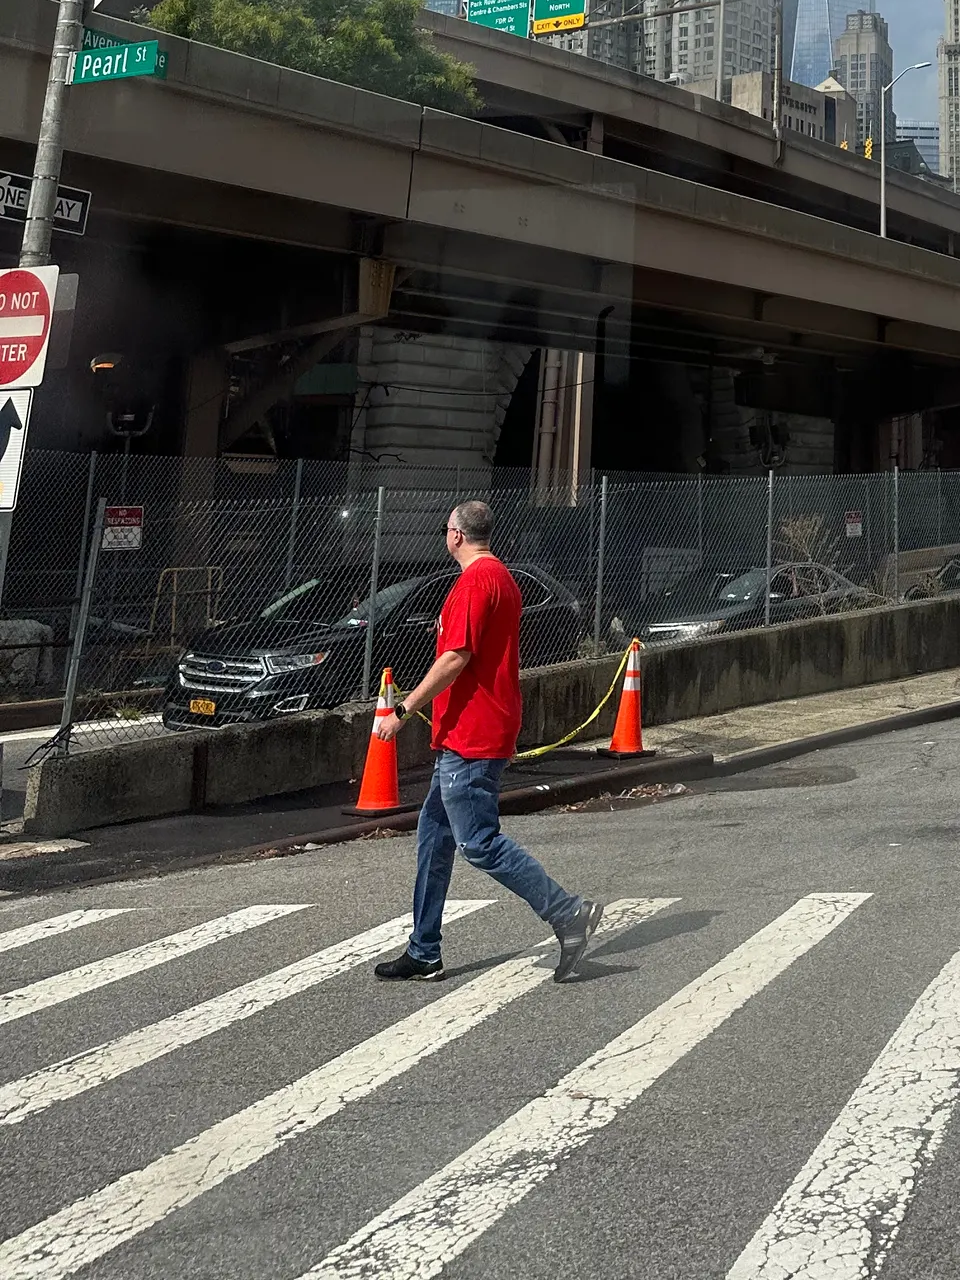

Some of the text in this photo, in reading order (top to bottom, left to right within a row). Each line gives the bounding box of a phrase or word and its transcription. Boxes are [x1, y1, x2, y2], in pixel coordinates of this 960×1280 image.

[470, 9, 486, 17] Centre
[492, 3, 519, 13] Chambers
[536, 17, 581, 30] EXIT ONLY
[84, 30, 126, 49] Aven
[81, 48, 129, 79] Pearl
[135, 46, 147, 63] St
[54, 200, 76, 218] AY
[0, 292, 39, 310] O NOT
[0, 343, 28, 362] TER
